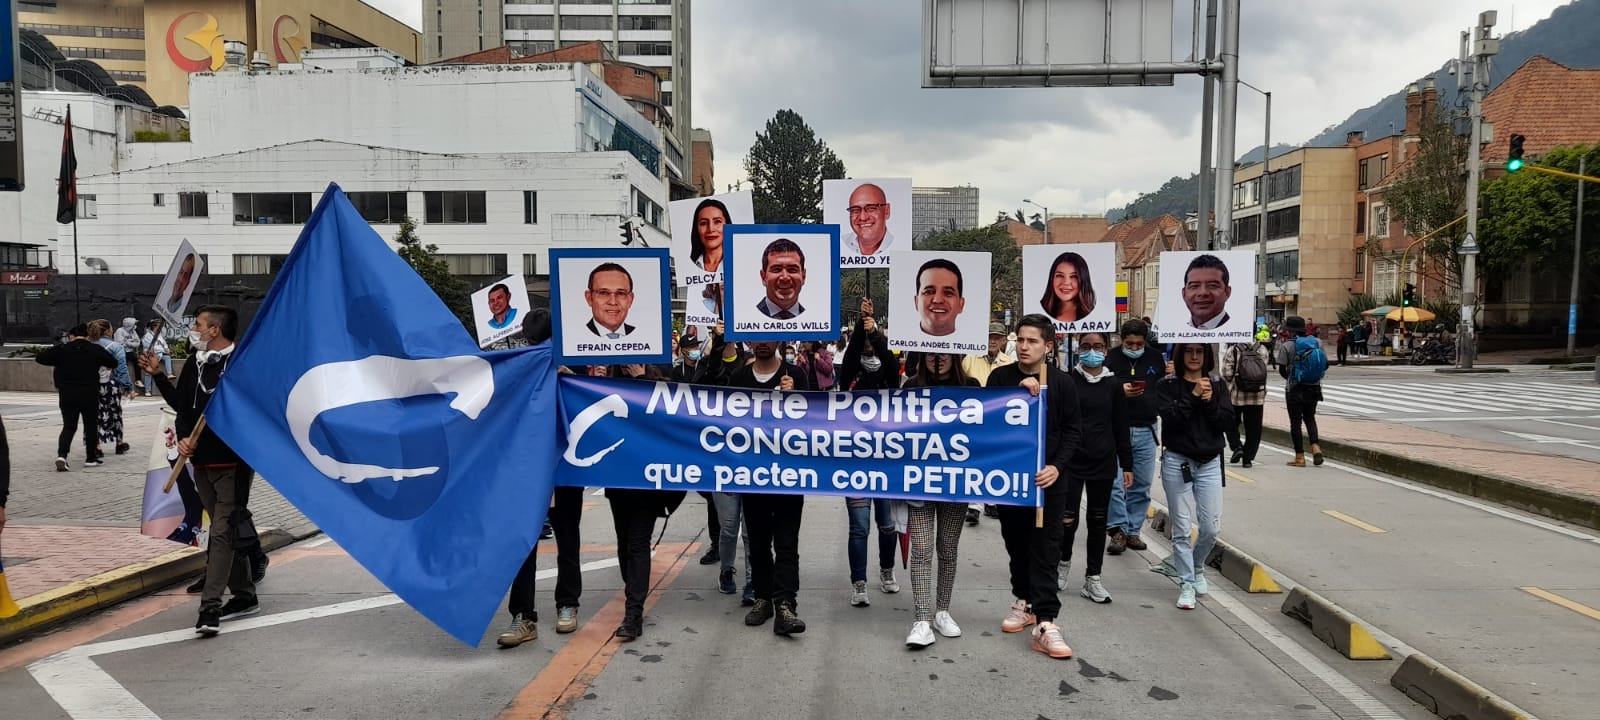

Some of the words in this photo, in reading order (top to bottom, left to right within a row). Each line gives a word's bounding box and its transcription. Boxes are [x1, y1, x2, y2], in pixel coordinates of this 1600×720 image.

[840, 255, 876, 265] RARDO
[685, 273, 716, 285] DELCY
[735, 322, 760, 330] JUAN
[763, 322, 798, 330] CARLOS
[800, 322, 830, 330] WILLS
[1052, 321, 1077, 332] ANA
[1081, 320, 1112, 331] ARAY
[614, 343, 651, 351] CEPEDA
[920, 340, 950, 349] ANDRÉS
[952, 342, 987, 351] TRUJILLO
[645, 381, 808, 419] Muerte
[827, 388, 984, 425] Política
[1004, 398, 1030, 426] a
[699, 425, 970, 462] CONGRESISTAS
[644, 462, 702, 490] que
[713, 462, 818, 491] pacten
[831, 469, 888, 491] con
[903, 465, 1030, 499] PETRO!!
